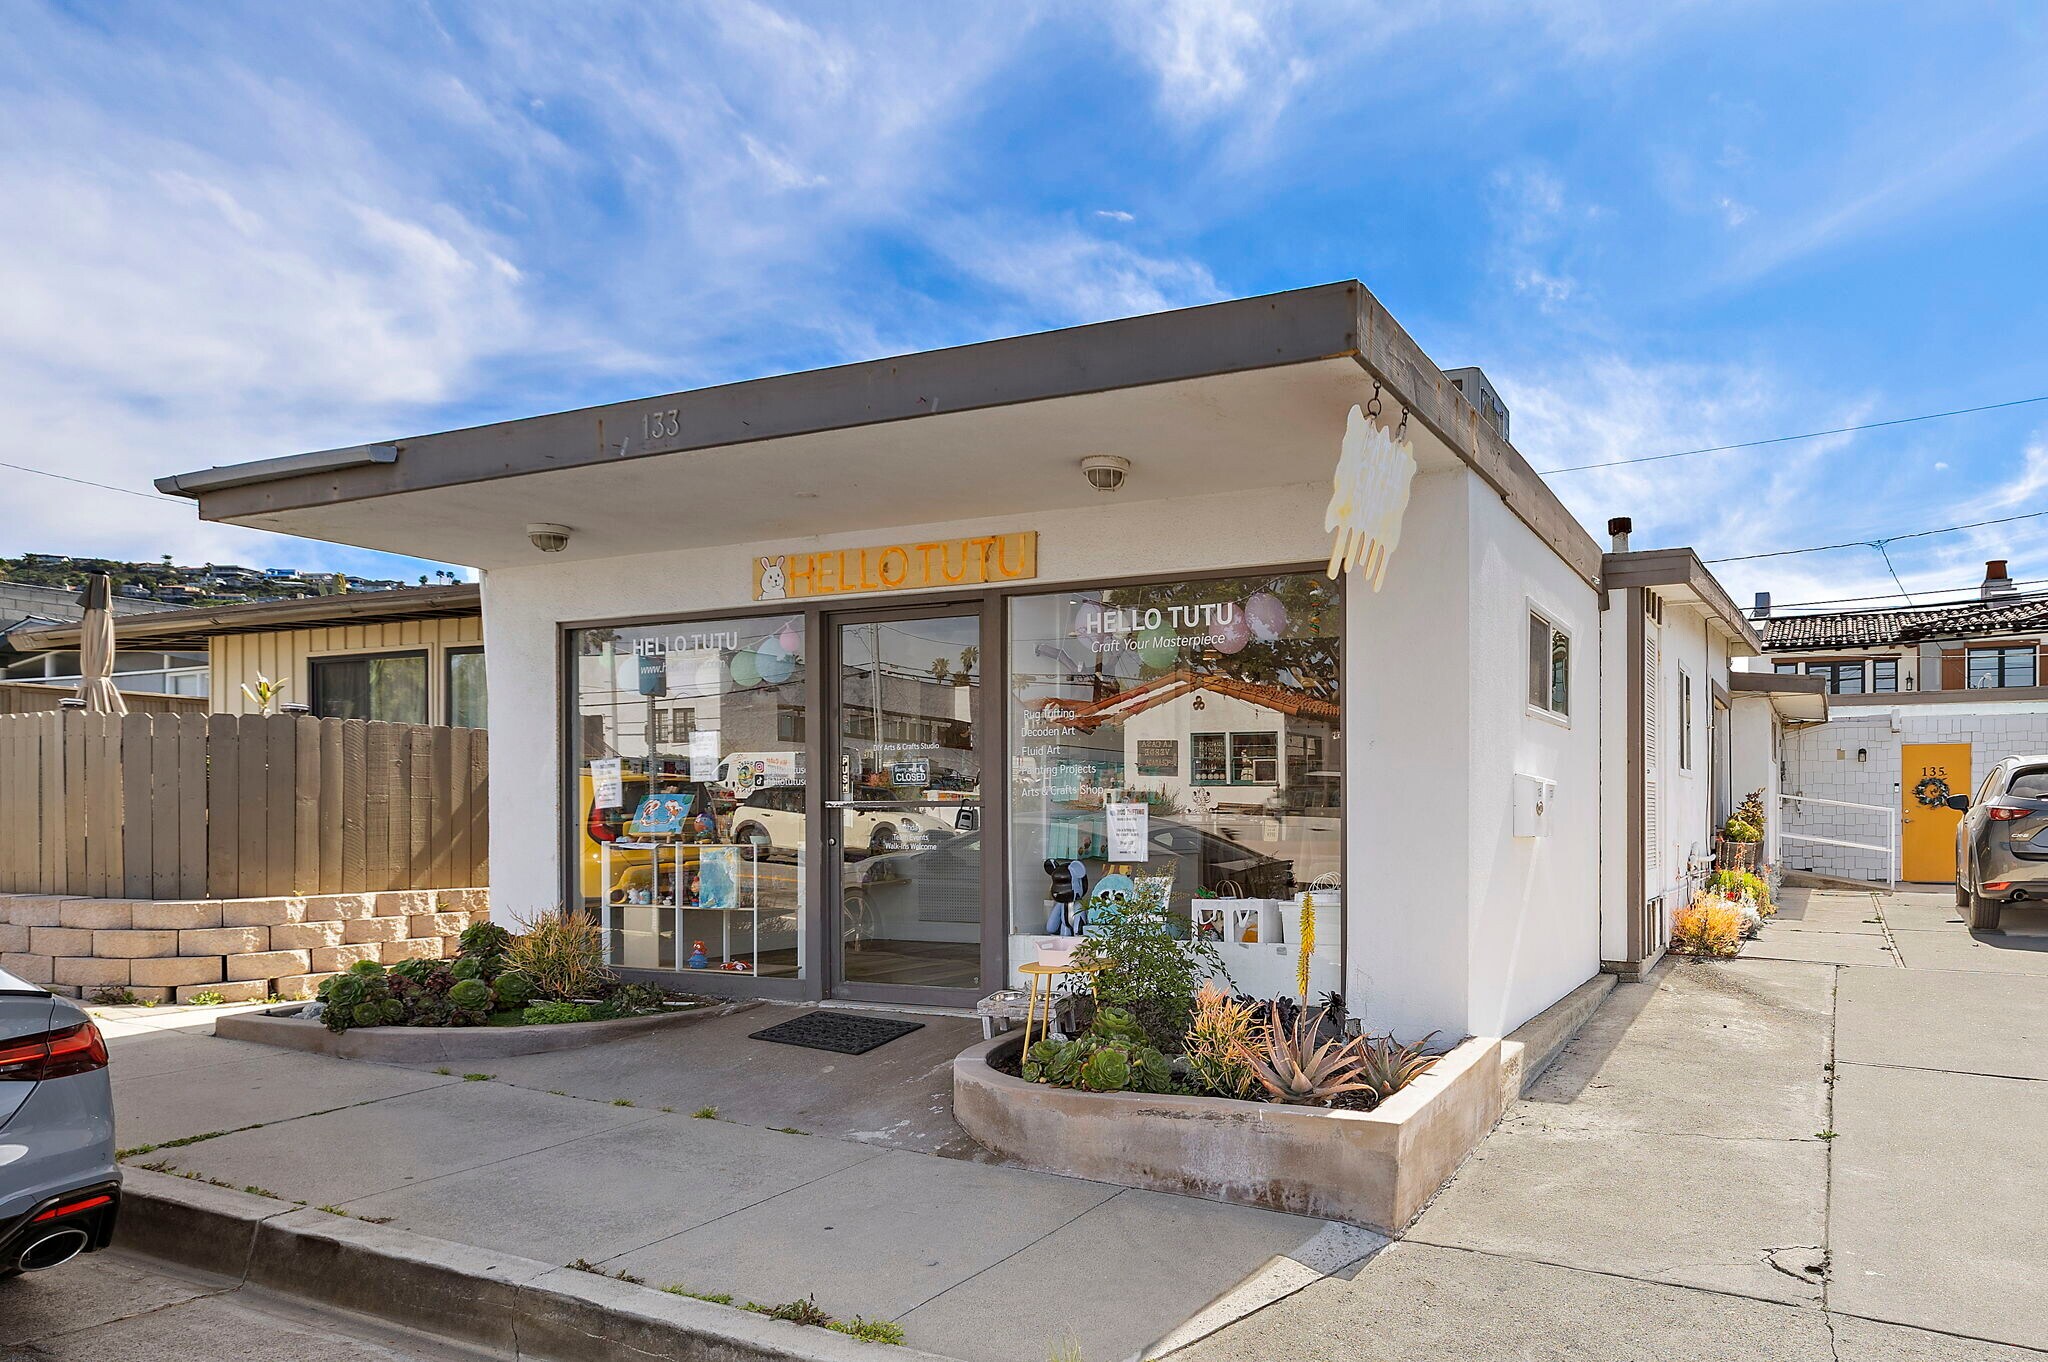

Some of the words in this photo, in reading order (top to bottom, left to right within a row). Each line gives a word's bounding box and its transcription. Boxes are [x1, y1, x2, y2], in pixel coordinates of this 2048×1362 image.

[642, 409, 680, 440] 133
[788, 546, 908, 595] HELLO
[916, 534, 1025, 585] TUTU
[1086, 607, 1162, 634] HELLO
[1167, 602, 1234, 628] TUTU
[632, 635, 687, 656] HELLO
[691, 631, 738, 653] TUTU
[1091, 640, 1120, 653] Craft
[1123, 639, 1150, 650] Your
[1152, 633, 1226, 649] Masterpiece
[1023, 709, 1041, 721] Rug
[1044, 708, 1075, 720] Tufting
[1021, 726, 1060, 737] Decoden
[1061, 726, 1076, 736] Art
[883, 743, 896, 751] Arts
[920, 742, 940, 750] Studio
[1021, 746, 1044, 756] Fluid
[1046, 745, 1061, 755] Art
[896, 772, 926, 782] CLOSED
[1021, 765, 1058, 777] Painting
[1059, 764, 1097, 776] Projects
[1921, 767, 1945, 777] 135
[1021, 788, 1040, 797] Arts
[1041, 786, 1048, 796] &
[1050, 785, 1078, 796] Crafts
[1080, 784, 1104, 796] Shop
[910, 842, 938, 851] Welcome
